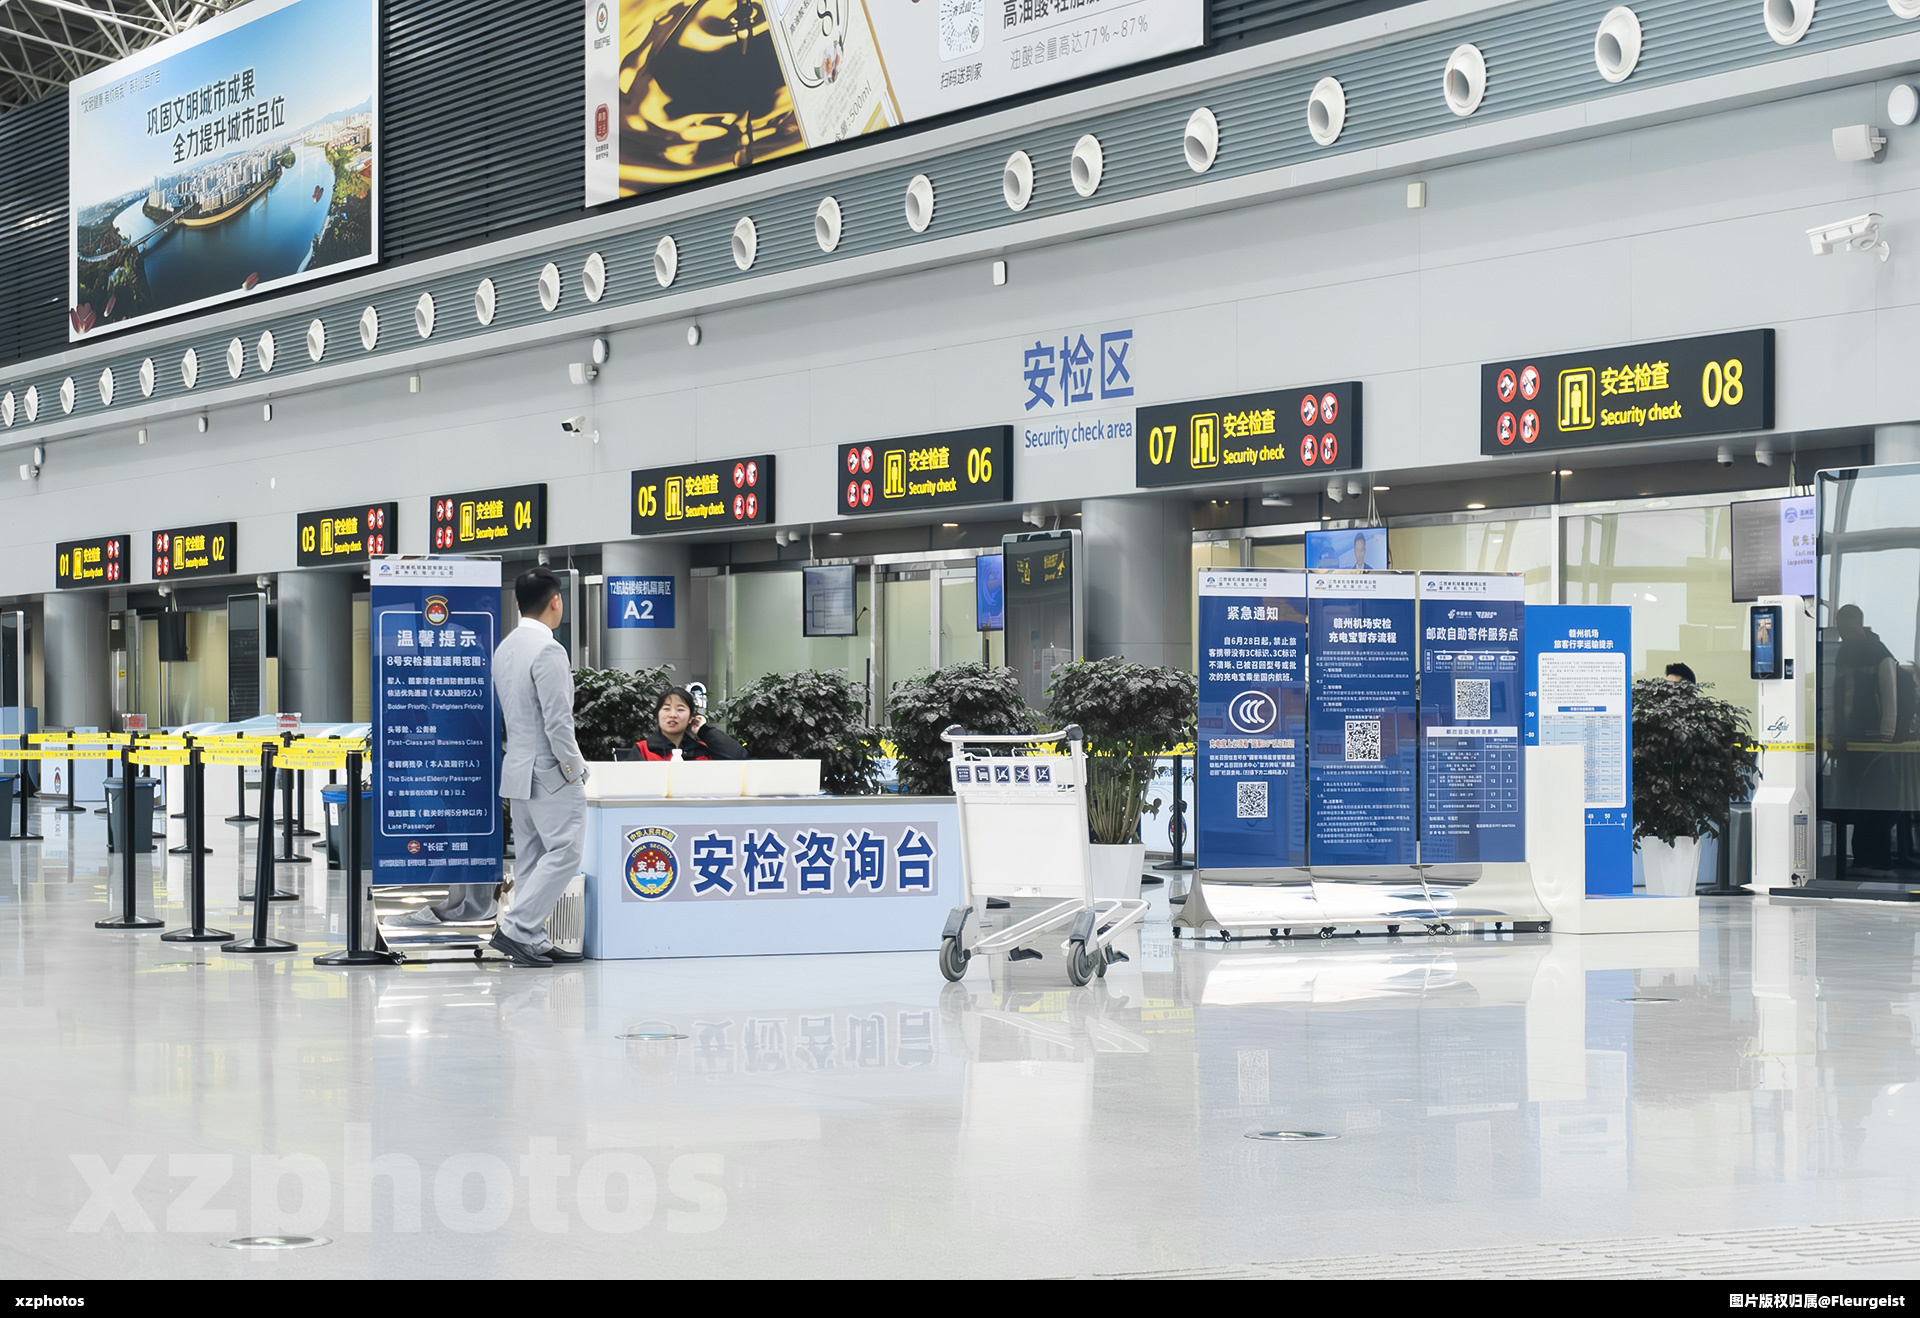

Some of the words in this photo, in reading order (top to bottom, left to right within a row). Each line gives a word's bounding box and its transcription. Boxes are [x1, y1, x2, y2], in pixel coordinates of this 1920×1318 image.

[940, 63, 983, 90] 扫码送到家
[147, 68, 256, 137] 巩固文明城市成果
[173, 96, 285, 164] 全力提升城市品位
[1024, 329, 1135, 411] 安检区
[1600, 360, 1670, 397] 安全检查
[1702, 358, 1744, 408] 08
[1223, 409, 1276, 438] 安全检查
[1600, 404, 1646, 429] Security
[1647, 400, 1682, 421] check
[1024, 424, 1069, 449] Security
[1071, 419, 1105, 443] check
[1105, 421, 1133, 440] area
[1149, 425, 1177, 465] 07
[909, 446, 950, 472] 安全检查
[967, 447, 992, 484] 06
[1223, 448, 1257, 467] Security
[1259, 444, 1285, 461] check
[685, 475, 719, 497] 安全检查
[909, 480, 935, 497] Security
[936, 477, 957, 494] check
[476, 500, 504, 520] 安全检查
[638, 485, 657, 517] 05
[685, 503, 707, 519] Security
[707, 501, 725, 517] check
[514, 500, 531, 530] 04
[334, 517, 358, 536] 安全检查
[476, 527, 494, 541] Security
[495, 526, 508, 538] check
[185, 535, 206, 552] 安全检查
[212, 536, 225, 562] 02
[302, 526, 315, 552] 03
[334, 542, 350, 555] Security
[350, 540, 362, 552] check
[59, 553, 69, 577] 01
[624, 600, 654, 619] A2
[1227, 606, 1279, 620] 紧急通知
[1333, 617, 1392, 629] 赣州机场安检
[1426, 627, 1519, 641] 邮政自助寄件服务点
[1568, 629, 1599, 638] 赣州机场
[397, 630, 477, 647] 温馨提示
[1328, 632, 1397, 643] 充电宝暂存流程
[1553, 639, 1614, 649] 旅客行李运输提示
[427, 775, 449, 783] Elderly
[449, 775, 482, 783] Passenger
[402, 823, 436, 831] Passenger
[631, 845, 647, 858] CHINA
[649, 843, 673, 859] SECURITY
[693, 830, 935, 894] 安检咨询台
[637, 860, 666, 871] 安检
